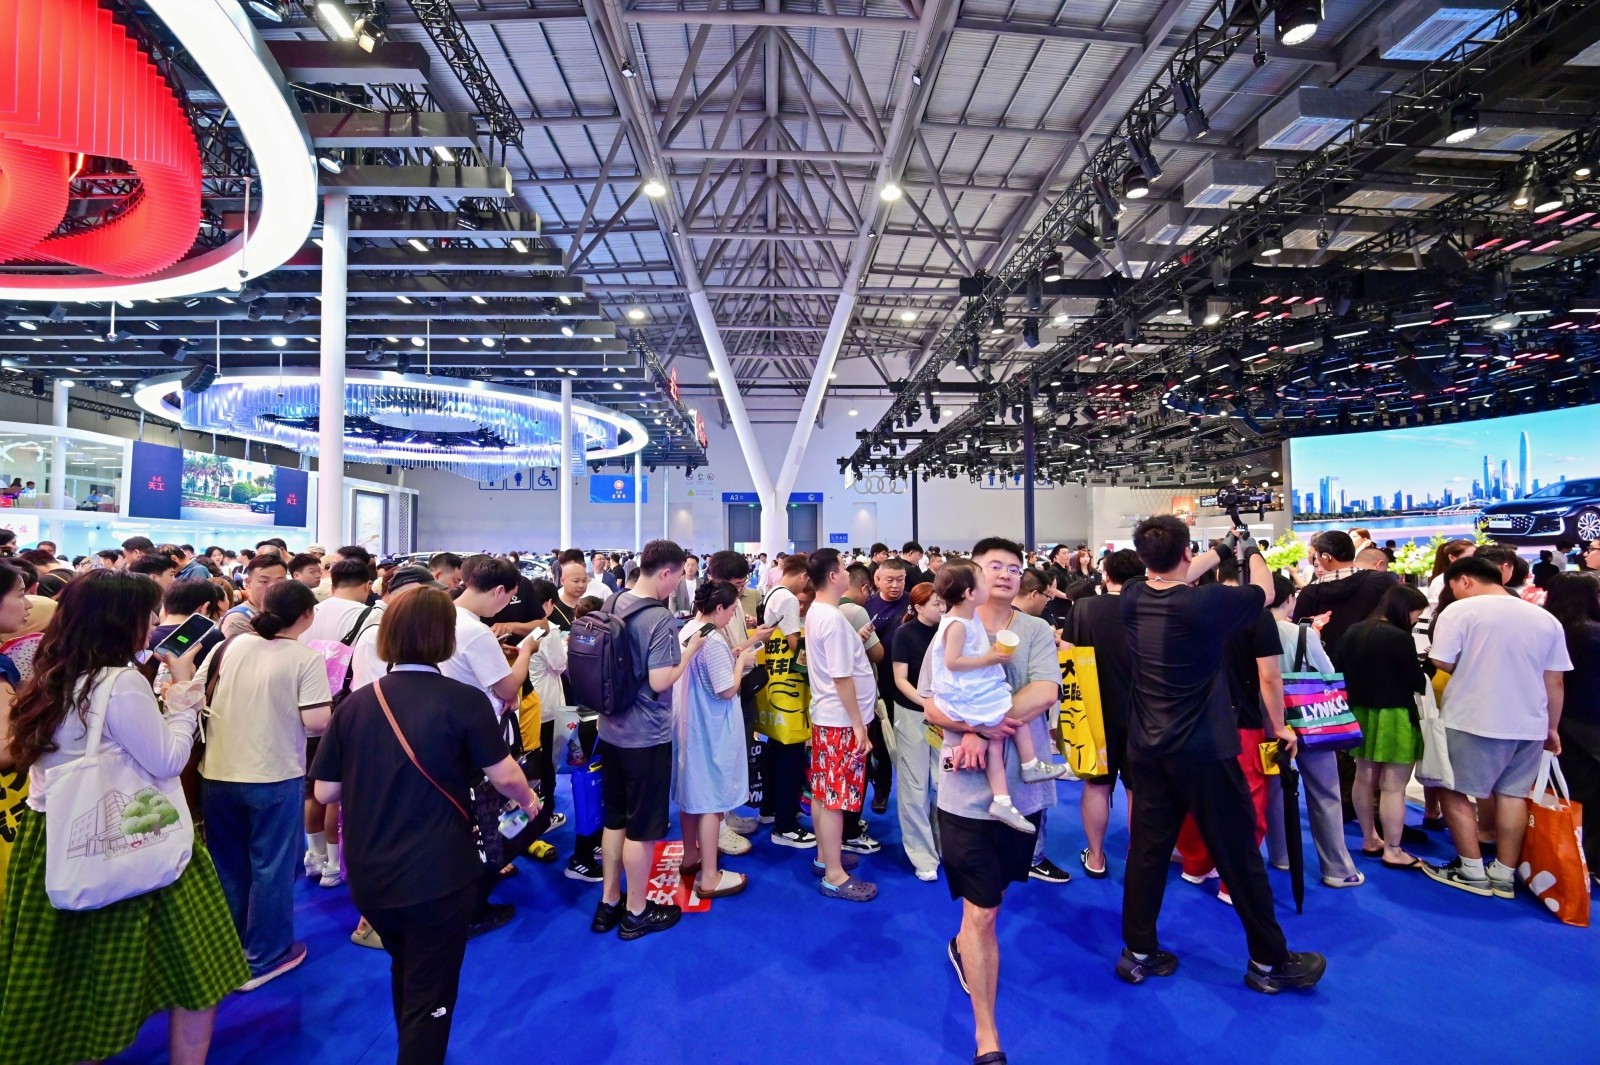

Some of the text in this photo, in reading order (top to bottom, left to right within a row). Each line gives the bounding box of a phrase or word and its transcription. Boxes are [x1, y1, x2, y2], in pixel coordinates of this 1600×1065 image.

[148, 481, 165, 491] 天工
[645, 844, 685, 906] 安全出口
